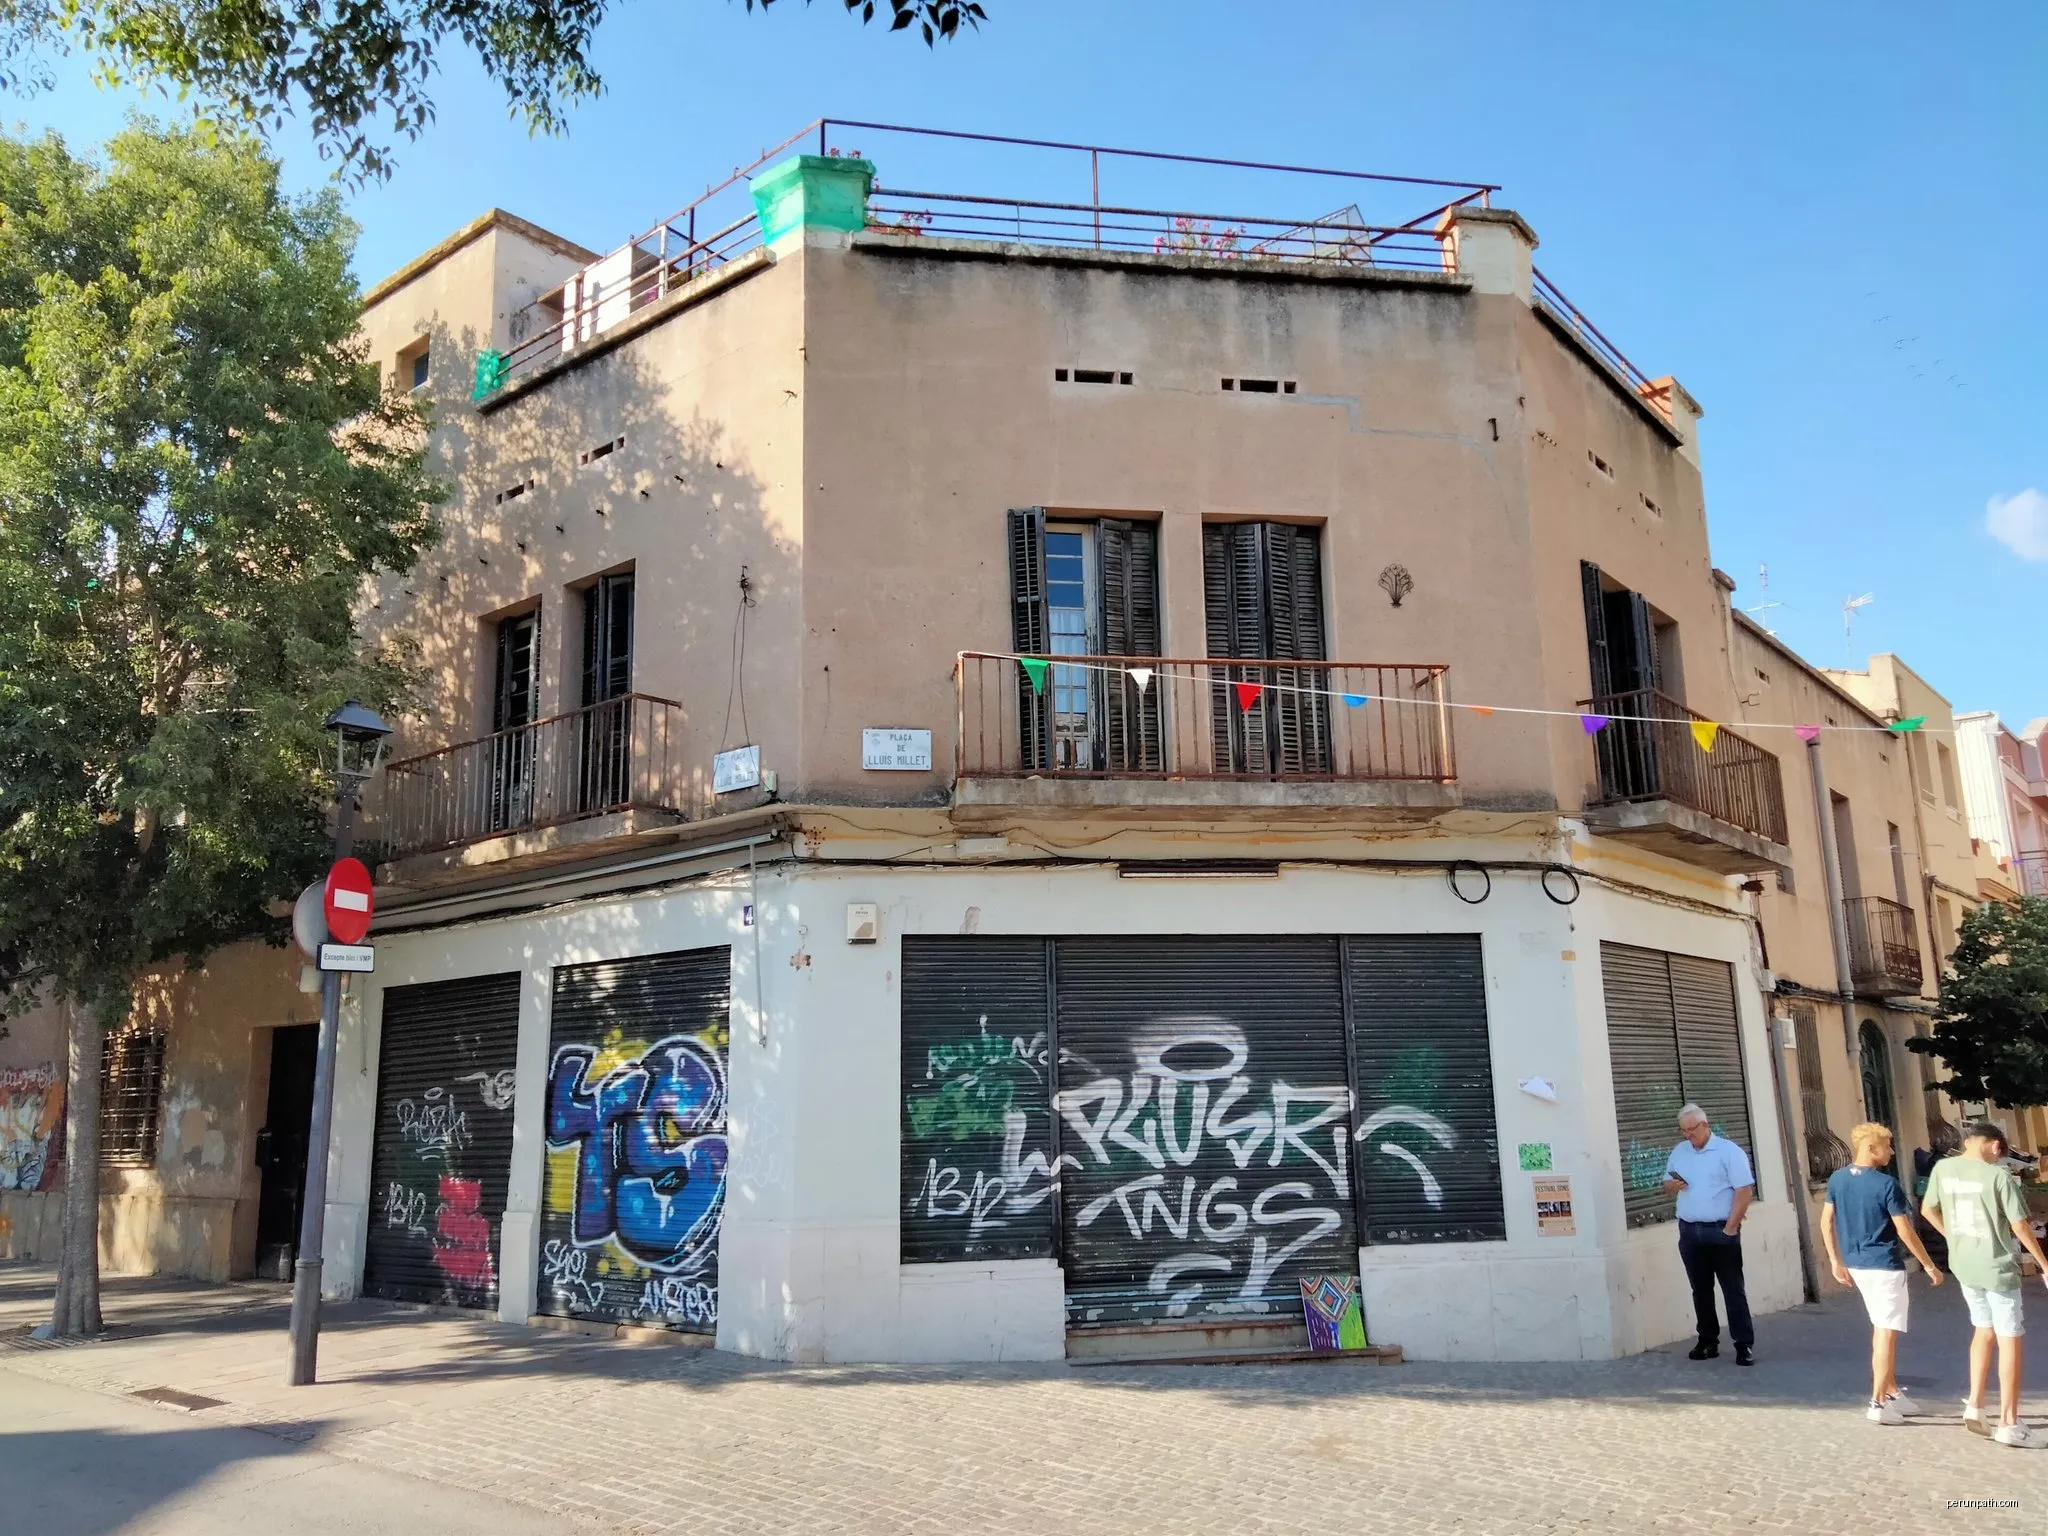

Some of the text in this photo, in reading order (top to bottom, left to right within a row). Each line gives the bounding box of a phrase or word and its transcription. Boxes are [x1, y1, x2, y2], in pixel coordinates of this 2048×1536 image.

[890, 733, 912, 742] PLAÇA
[897, 744, 906, 752] DE
[897, 755, 926, 766] MILLET
[745, 905, 753, 925] 4
[324, 953, 345, 962] Excepte
[1535, 1185, 1556, 1193] FESTIVAL
